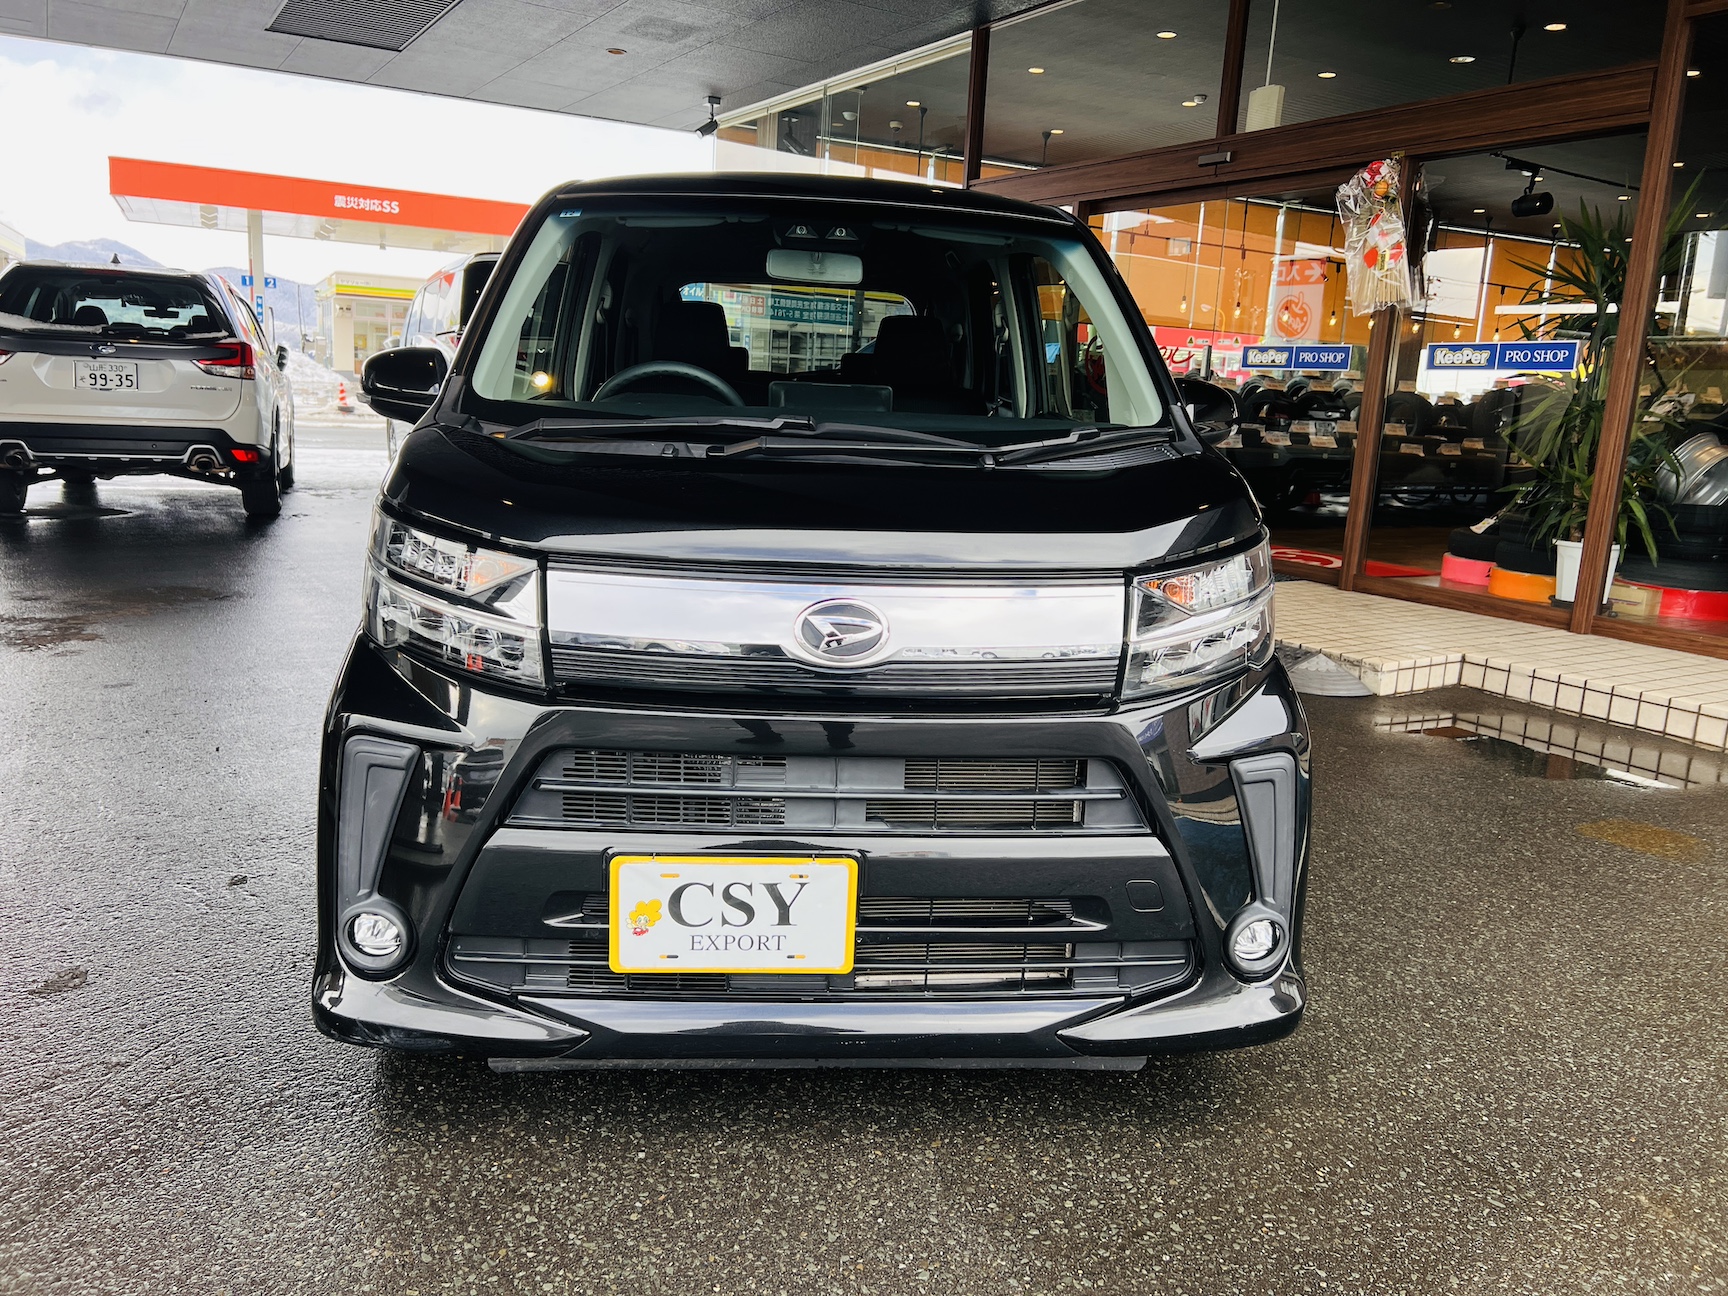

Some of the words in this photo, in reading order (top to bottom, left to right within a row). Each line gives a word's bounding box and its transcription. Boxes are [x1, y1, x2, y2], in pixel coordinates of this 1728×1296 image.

[334, 194, 399, 214] 震災対応SS
[244, 276, 250, 286] 1
[266, 278, 275, 288] 2
[1247, 349, 1289, 365] KeePer
[1299, 352, 1318, 363] PRO
[1319, 352, 1345, 363] SHOP
[1434, 348, 1490, 366] KeePer
[1504, 350, 1531, 363] PRO
[1532, 349, 1568, 363] SHOP
[108, 364, 124, 372] 330
[89, 372, 134, 388] 99-35
[668, 882, 810, 928] CSY
[689, 934, 787, 951] EXPORT
